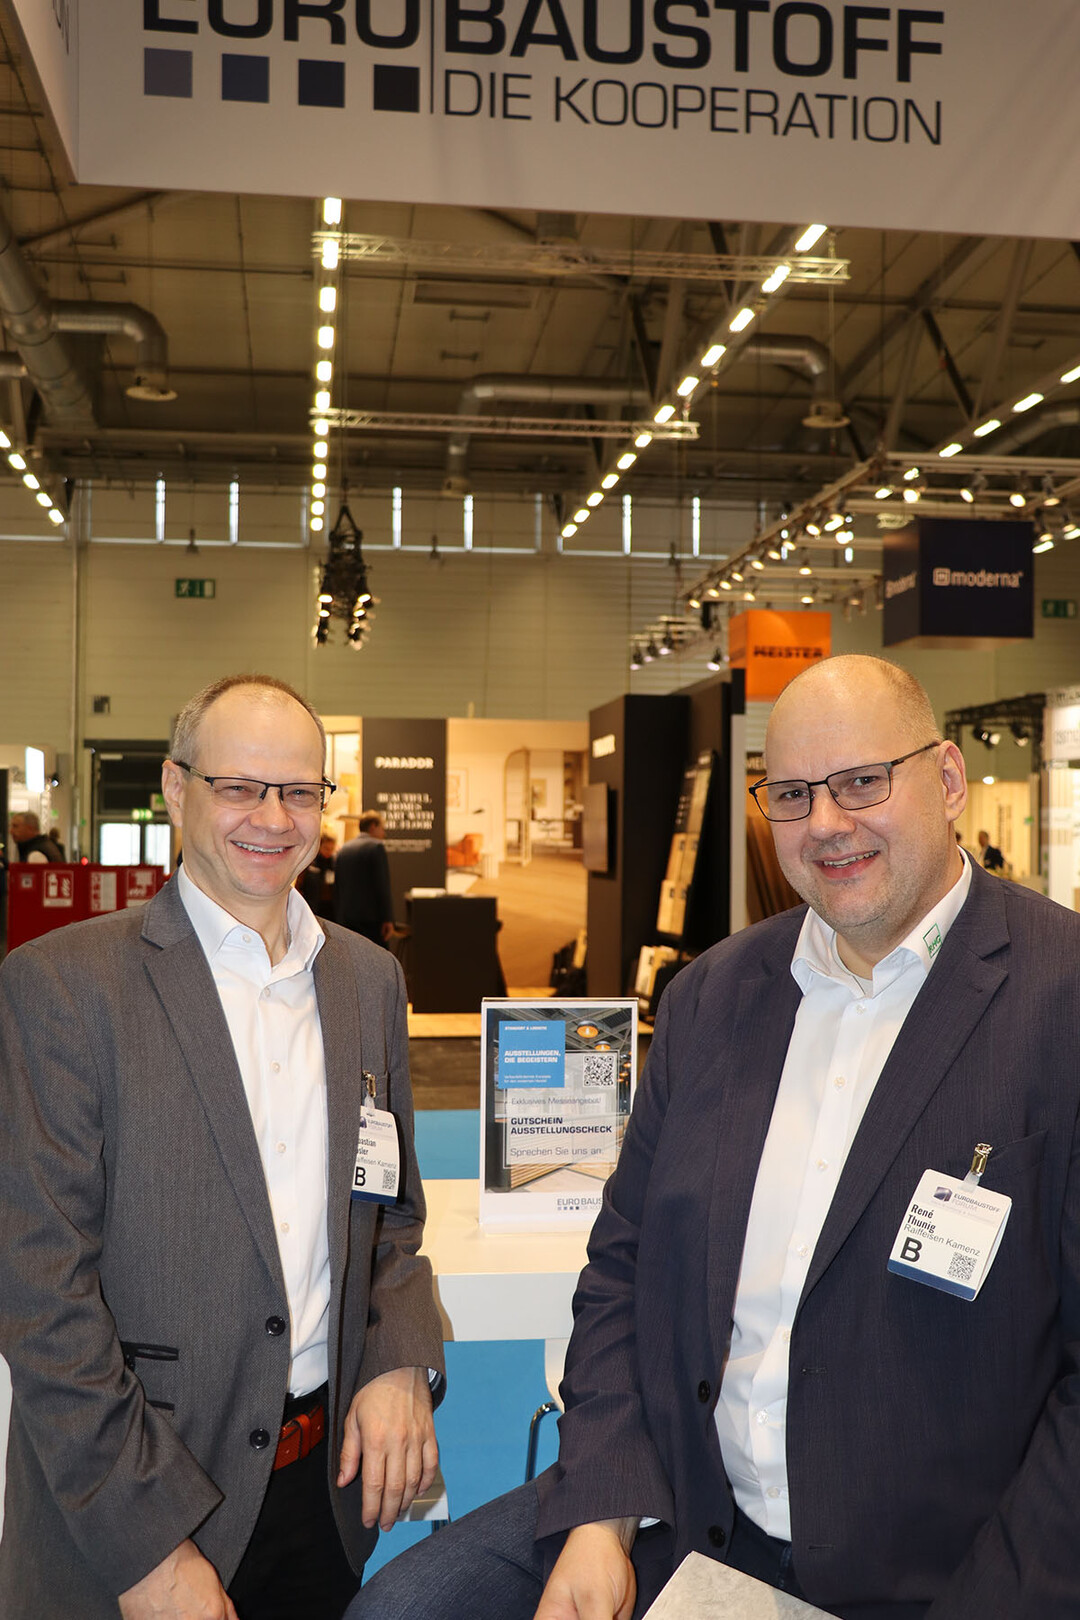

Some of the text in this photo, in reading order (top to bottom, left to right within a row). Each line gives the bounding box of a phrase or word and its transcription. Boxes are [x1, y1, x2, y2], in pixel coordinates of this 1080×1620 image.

[445, 69, 942, 145] DIE KOOPERATION
[951, 569, 1020, 588] moderna
[754, 646, 823, 658] MEISTER
[375, 757, 434, 769] PARADOR
[511, 1117, 563, 1125] GUTSCHEIN
[510, 1126, 612, 1134] AUSSTELLUNGSCHECK
[510, 1147, 552, 1158] Sprechen
[555, 1147, 569, 1156] Sie
[355, 1166, 366, 1187] B
[581, 1197, 603, 1205] BAUS
[953, 1193, 1000, 1213] EUROBAUSTOFF
[911, 1204, 934, 1218] René
[908, 1214, 936, 1233] Thunig
[904, 1224, 980, 1257] Raiffeisen Kamenz
[900, 1237, 922, 1262] B
